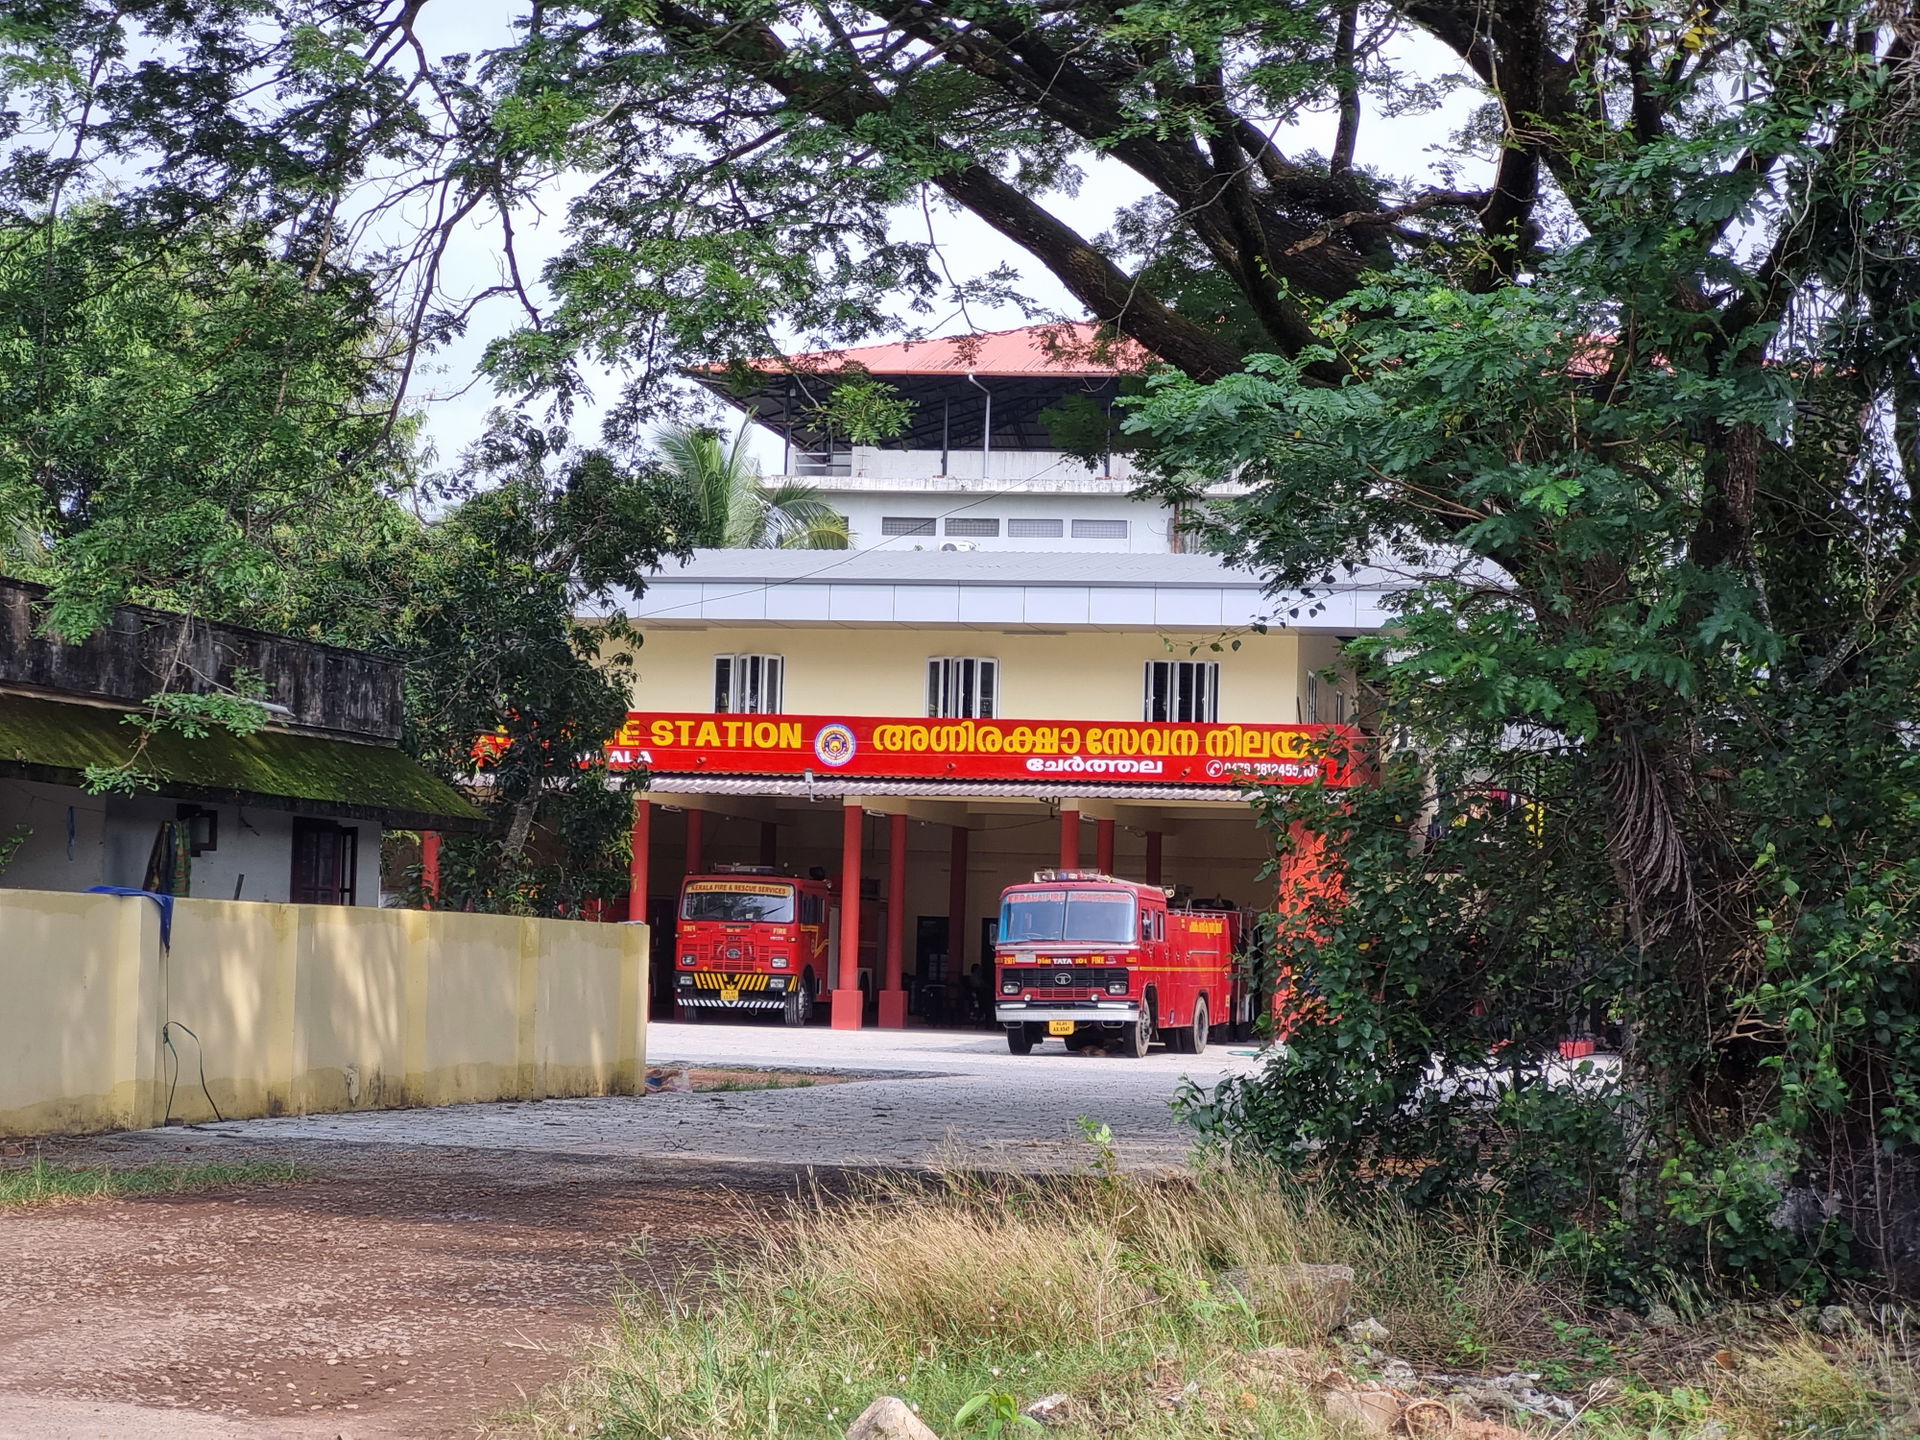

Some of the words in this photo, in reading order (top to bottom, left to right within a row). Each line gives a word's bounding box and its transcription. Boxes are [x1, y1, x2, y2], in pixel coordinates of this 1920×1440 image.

[651, 720, 802, 748] STATION
[873, 721, 1080, 754] അഗ്നിരക്ഷാ
[1086, 728, 1199, 756] സേവന
[1026, 756, 1163, 773] ചേർത്തല
[734, 885, 758, 893] RESCUE
[758, 886, 785, 895] SERVICES
[1091, 956, 1105, 965] FIRE
